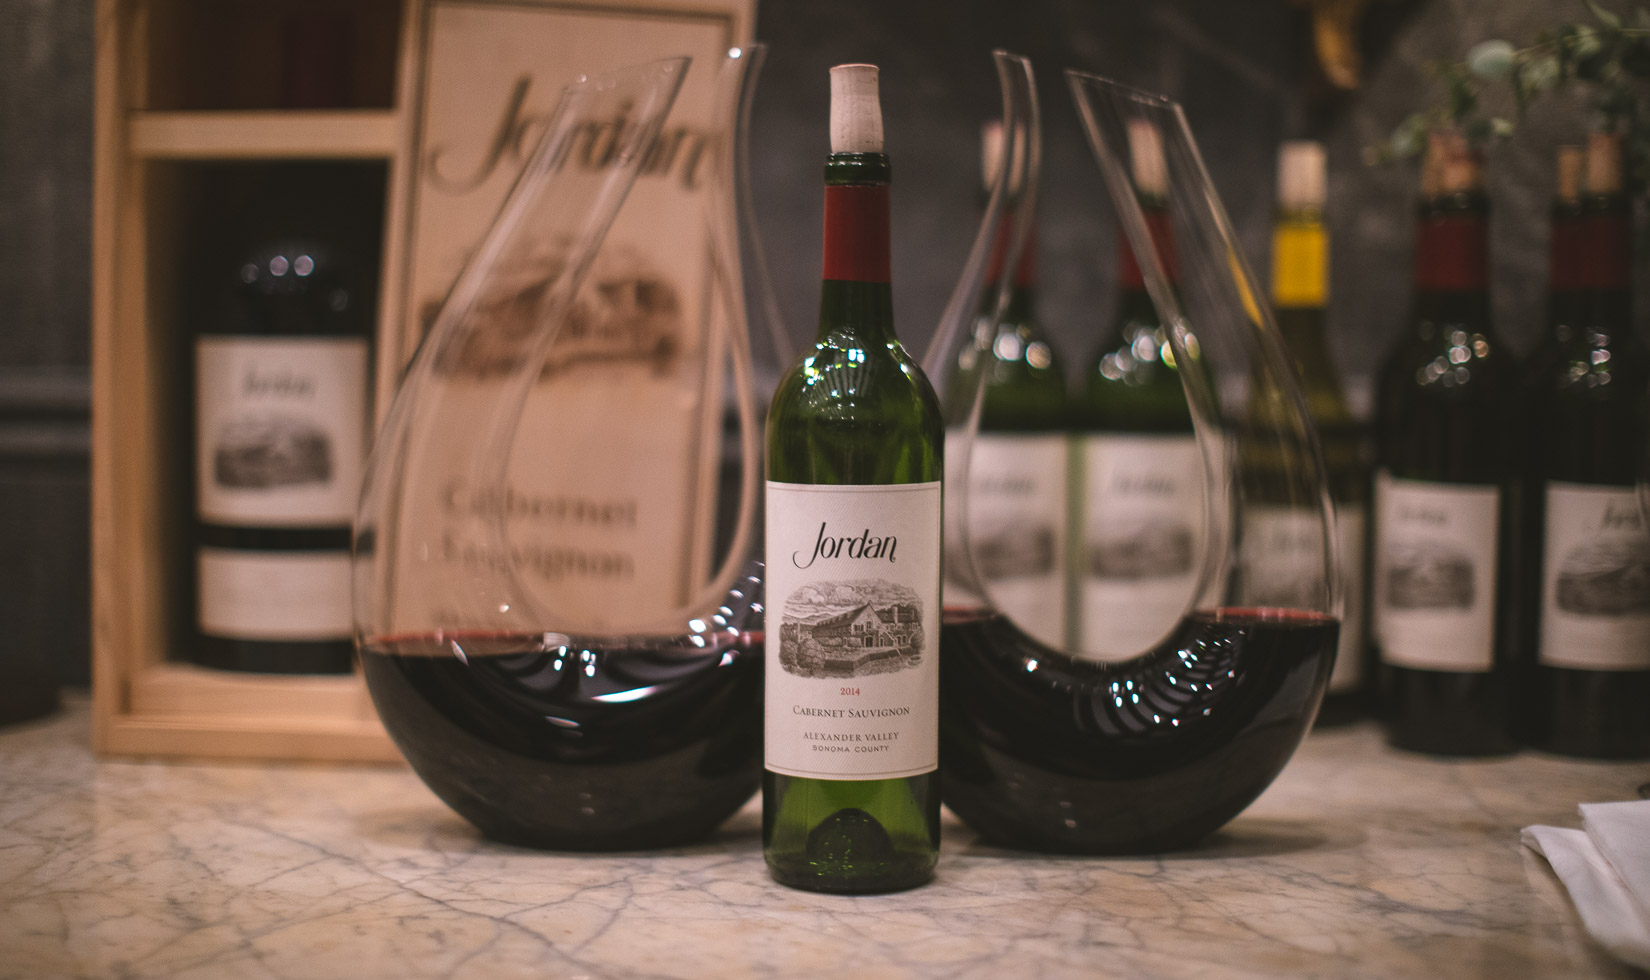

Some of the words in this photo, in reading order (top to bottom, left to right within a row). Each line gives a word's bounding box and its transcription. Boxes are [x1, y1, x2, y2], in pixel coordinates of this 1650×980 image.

[792, 521, 897, 569] Jordan
[840, 687, 861, 696] 2014
[792, 705, 845, 718] CABERNET
[847, 706, 910, 718] SAUVIGNON
[803, 731, 862, 742] ALEXANDER
[864, 731, 899, 741] VALLEY
[812, 744, 850, 753] SONOMA
[854, 745, 889, 753] COUNTY
